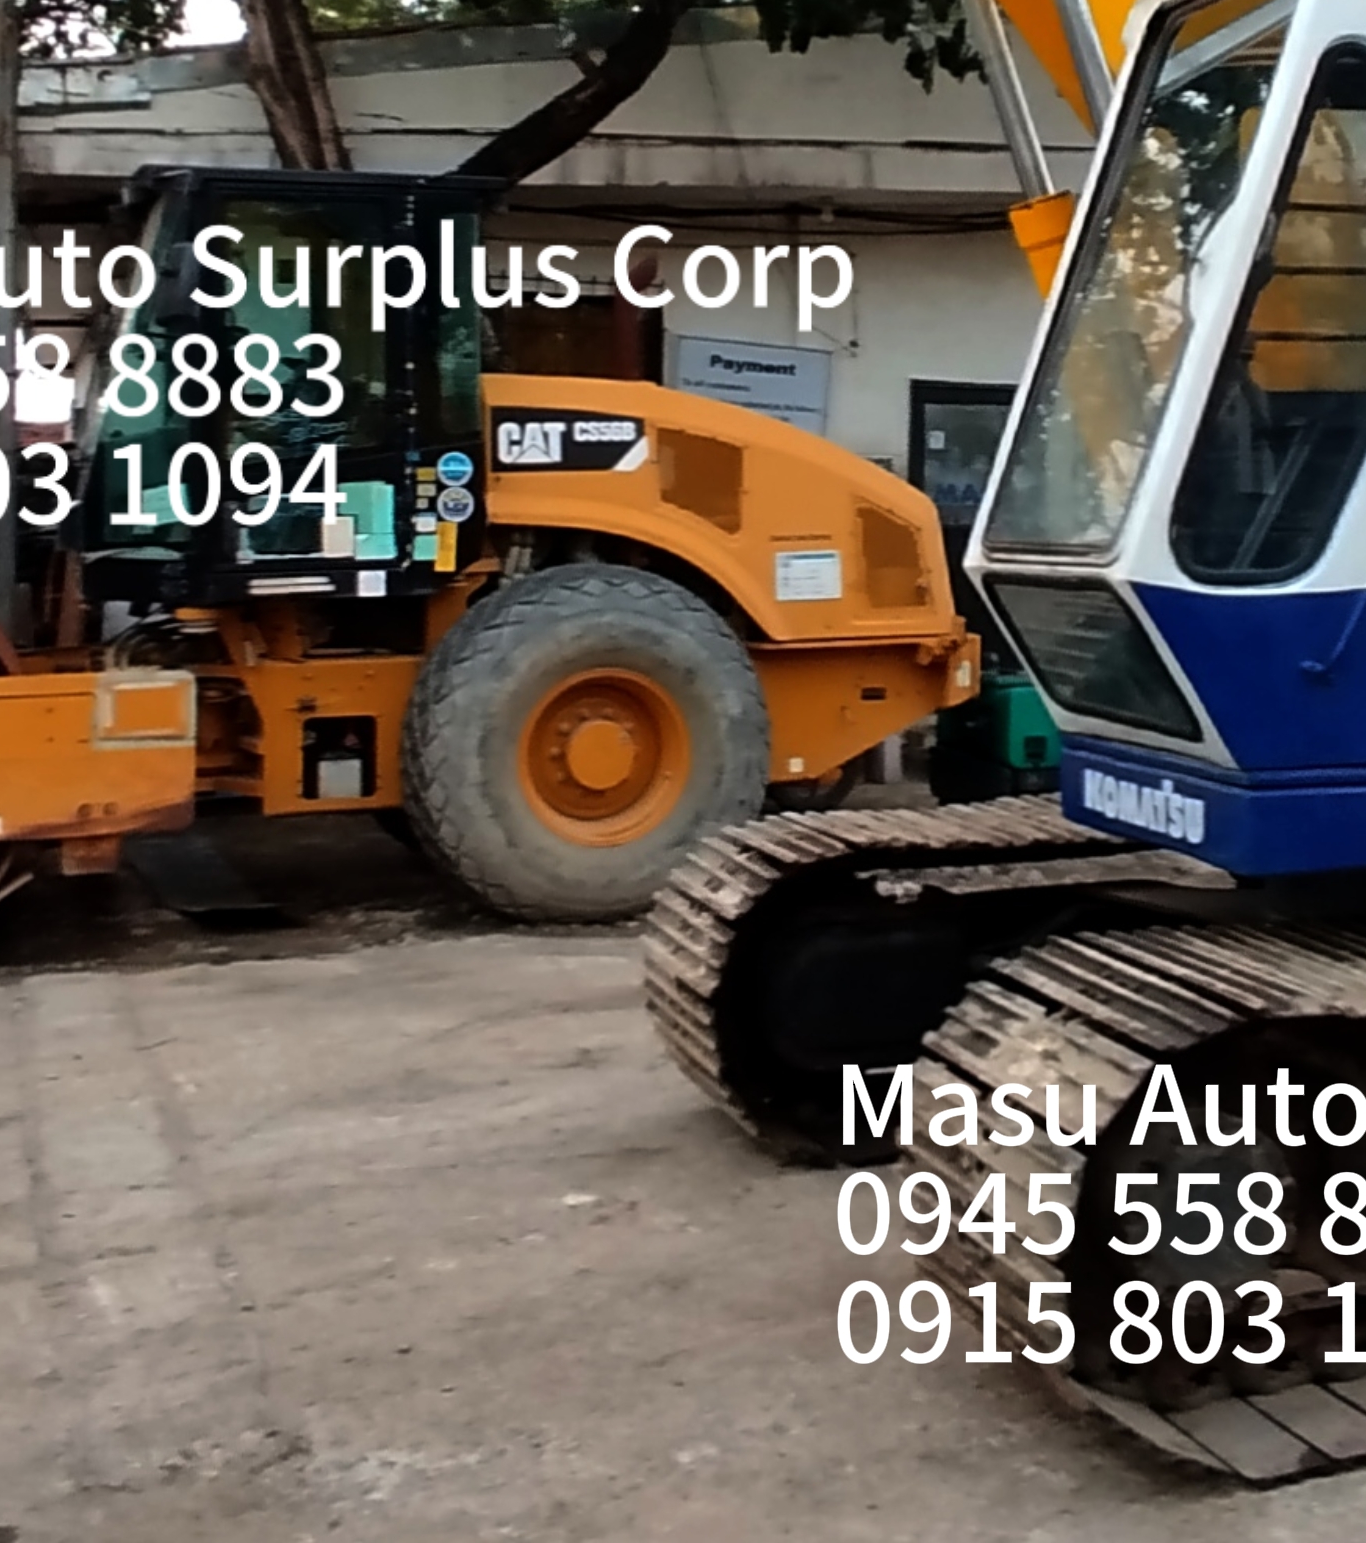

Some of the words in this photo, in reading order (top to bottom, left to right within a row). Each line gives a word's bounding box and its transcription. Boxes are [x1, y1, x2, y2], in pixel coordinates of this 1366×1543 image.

[709, 354, 797, 376] Payment
[497, 421, 567, 464] CAT
[1083, 768, 1205, 845] KOMATSU
